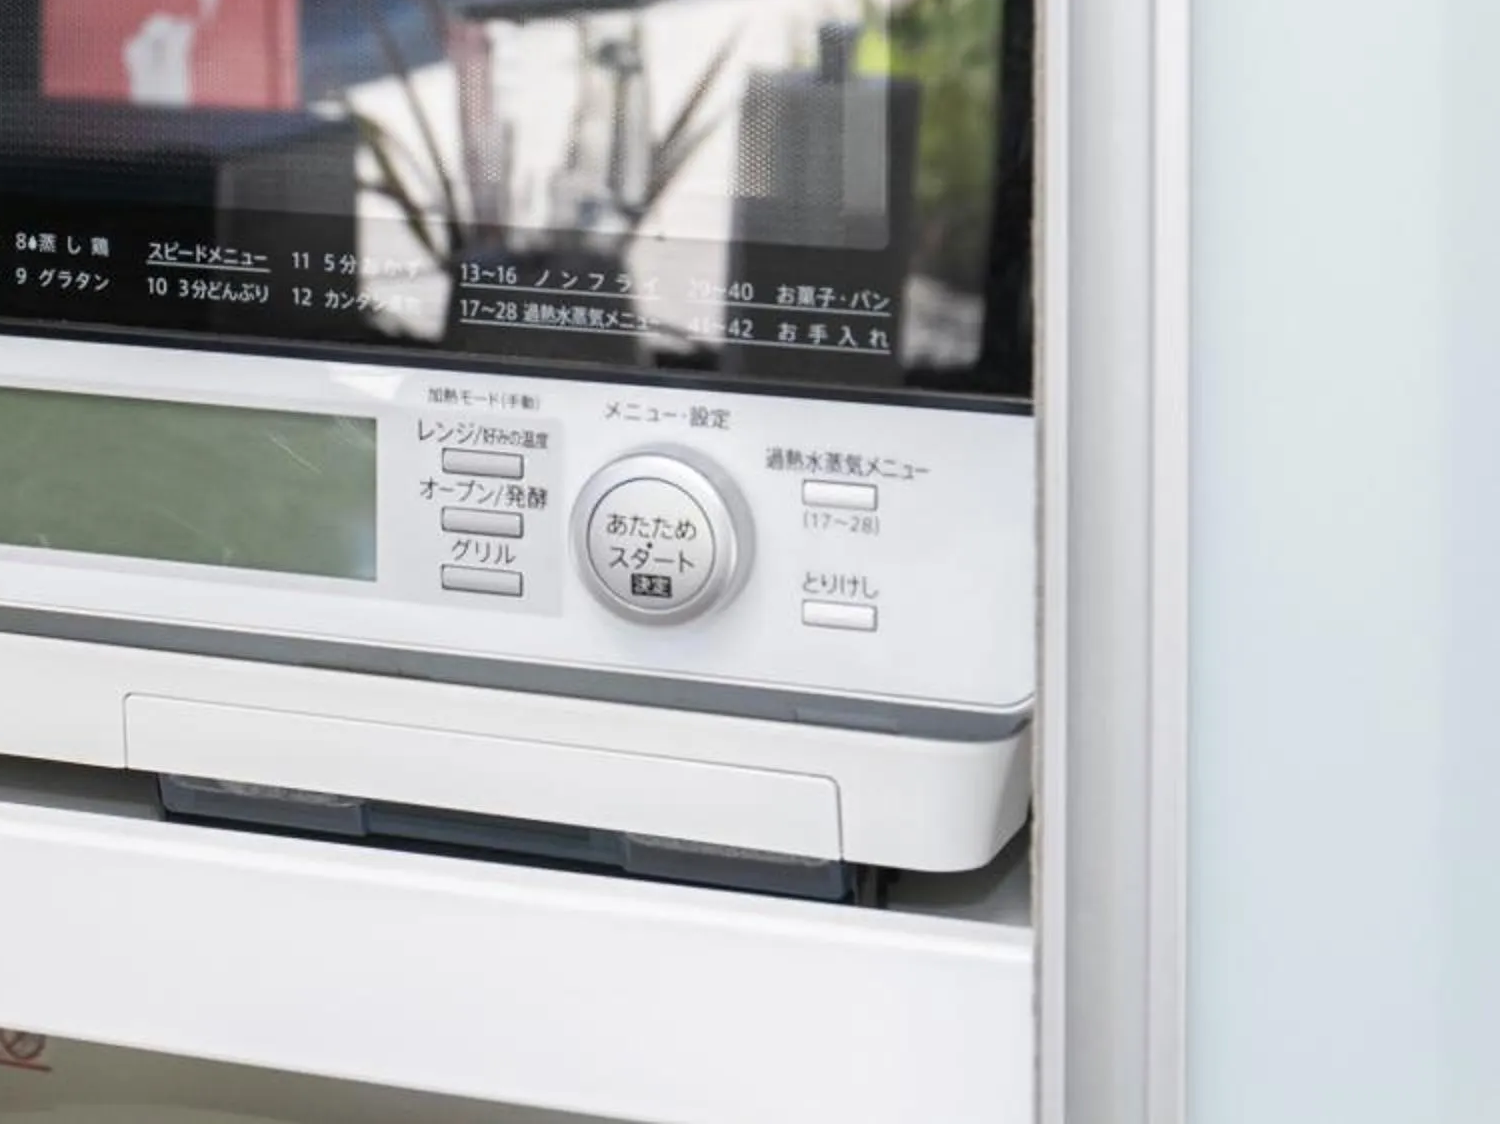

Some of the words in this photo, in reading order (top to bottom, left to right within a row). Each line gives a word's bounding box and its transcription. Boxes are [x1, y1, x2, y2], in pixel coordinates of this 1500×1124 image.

[148, 242, 268, 266] スピードメニュー
[291, 251, 310, 270] 11
[38, 267, 110, 292] グラタン
[148, 277, 168, 296] 10
[291, 287, 313, 307] 12
[777, 320, 890, 350] お手入れ
[606, 514, 697, 541] あたため
[451, 539, 518, 565] グリル
[802, 571, 880, 600] とりけし
